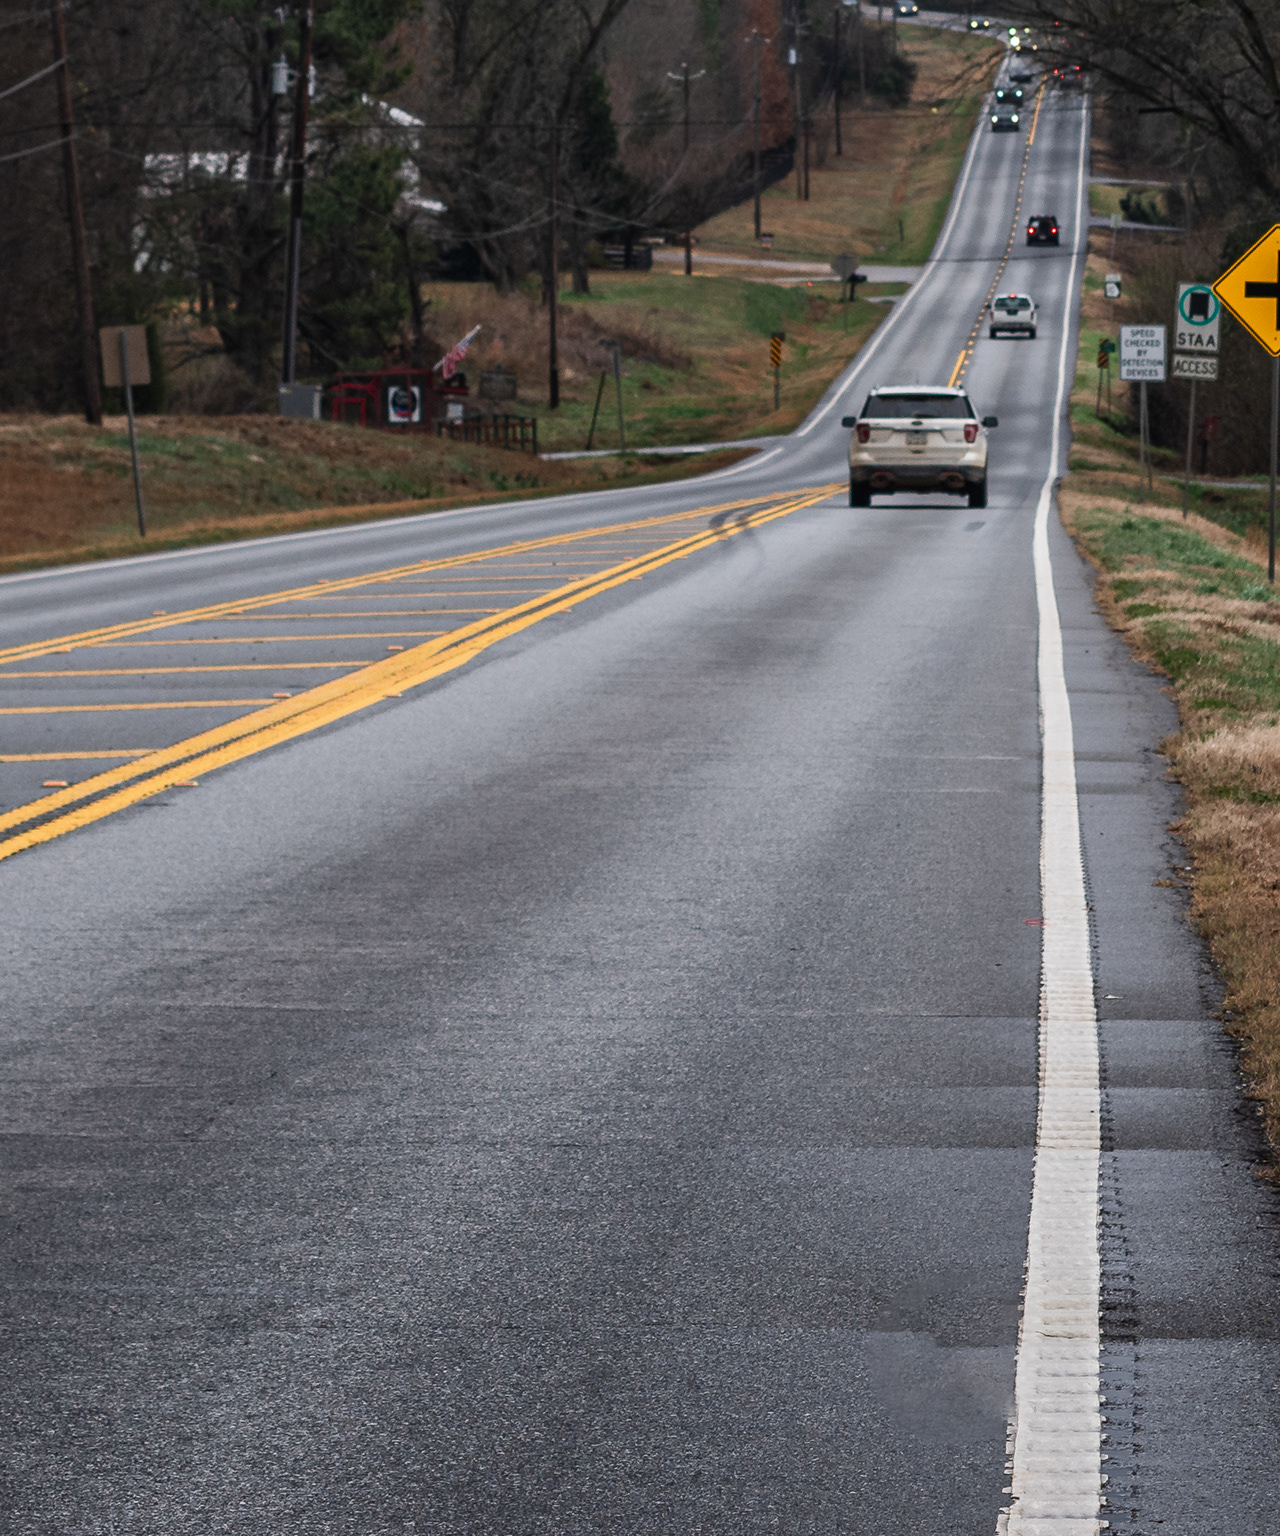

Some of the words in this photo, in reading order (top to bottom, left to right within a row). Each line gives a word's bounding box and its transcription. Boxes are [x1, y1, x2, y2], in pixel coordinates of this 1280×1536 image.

[1130, 328, 1156, 338] SPEED
[1124, 339, 1161, 348] CHECKED
[1177, 332, 1216, 347] STAA
[1136, 348, 1148, 357] BY
[1174, 359, 1217, 375] ACCESS
[1126, 368, 1159, 377] DEVICES
